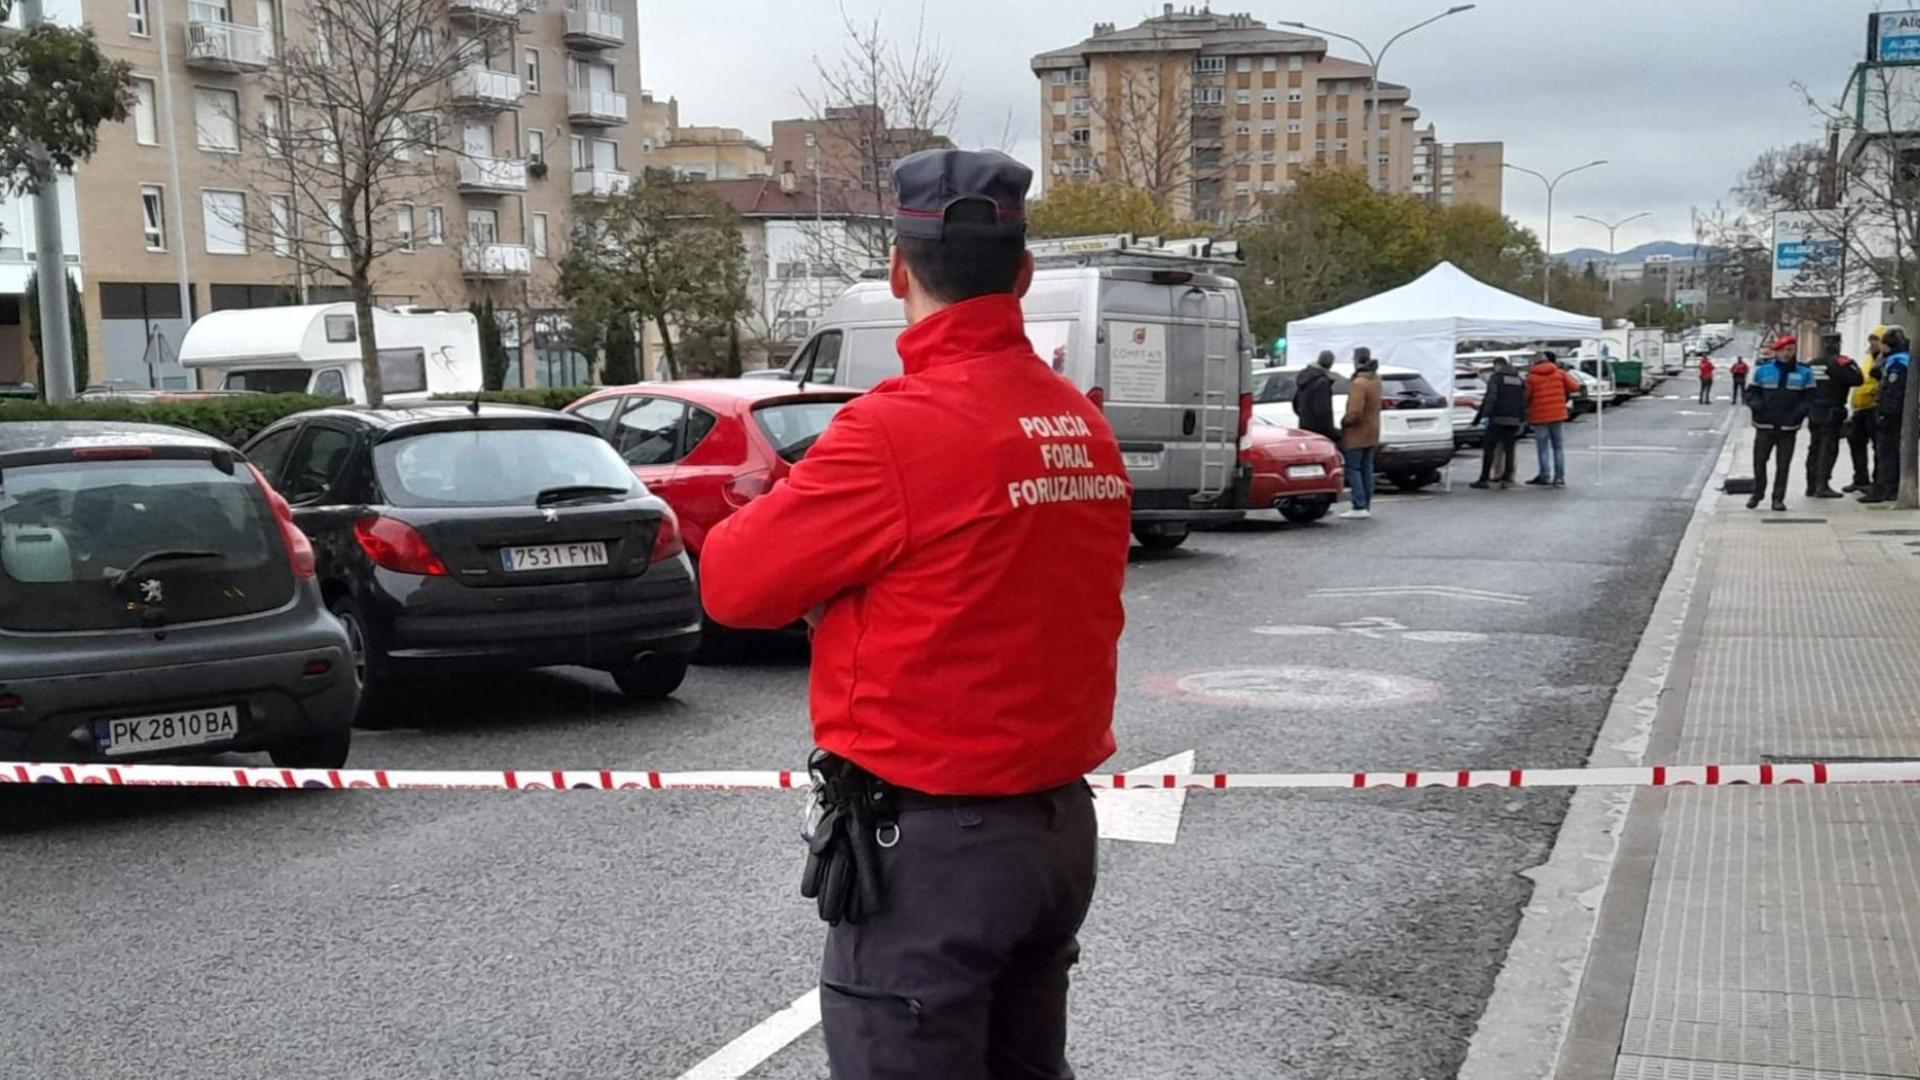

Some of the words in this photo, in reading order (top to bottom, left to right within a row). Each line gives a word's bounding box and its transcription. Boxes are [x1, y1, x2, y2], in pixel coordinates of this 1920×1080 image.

[1019, 411, 1091, 438] POLICÍA
[1040, 444, 1094, 470] FORAL
[1008, 475, 1126, 508] FORUZAINGOA
[514, 547, 563, 568] 7531
[568, 543, 605, 564] FYN
